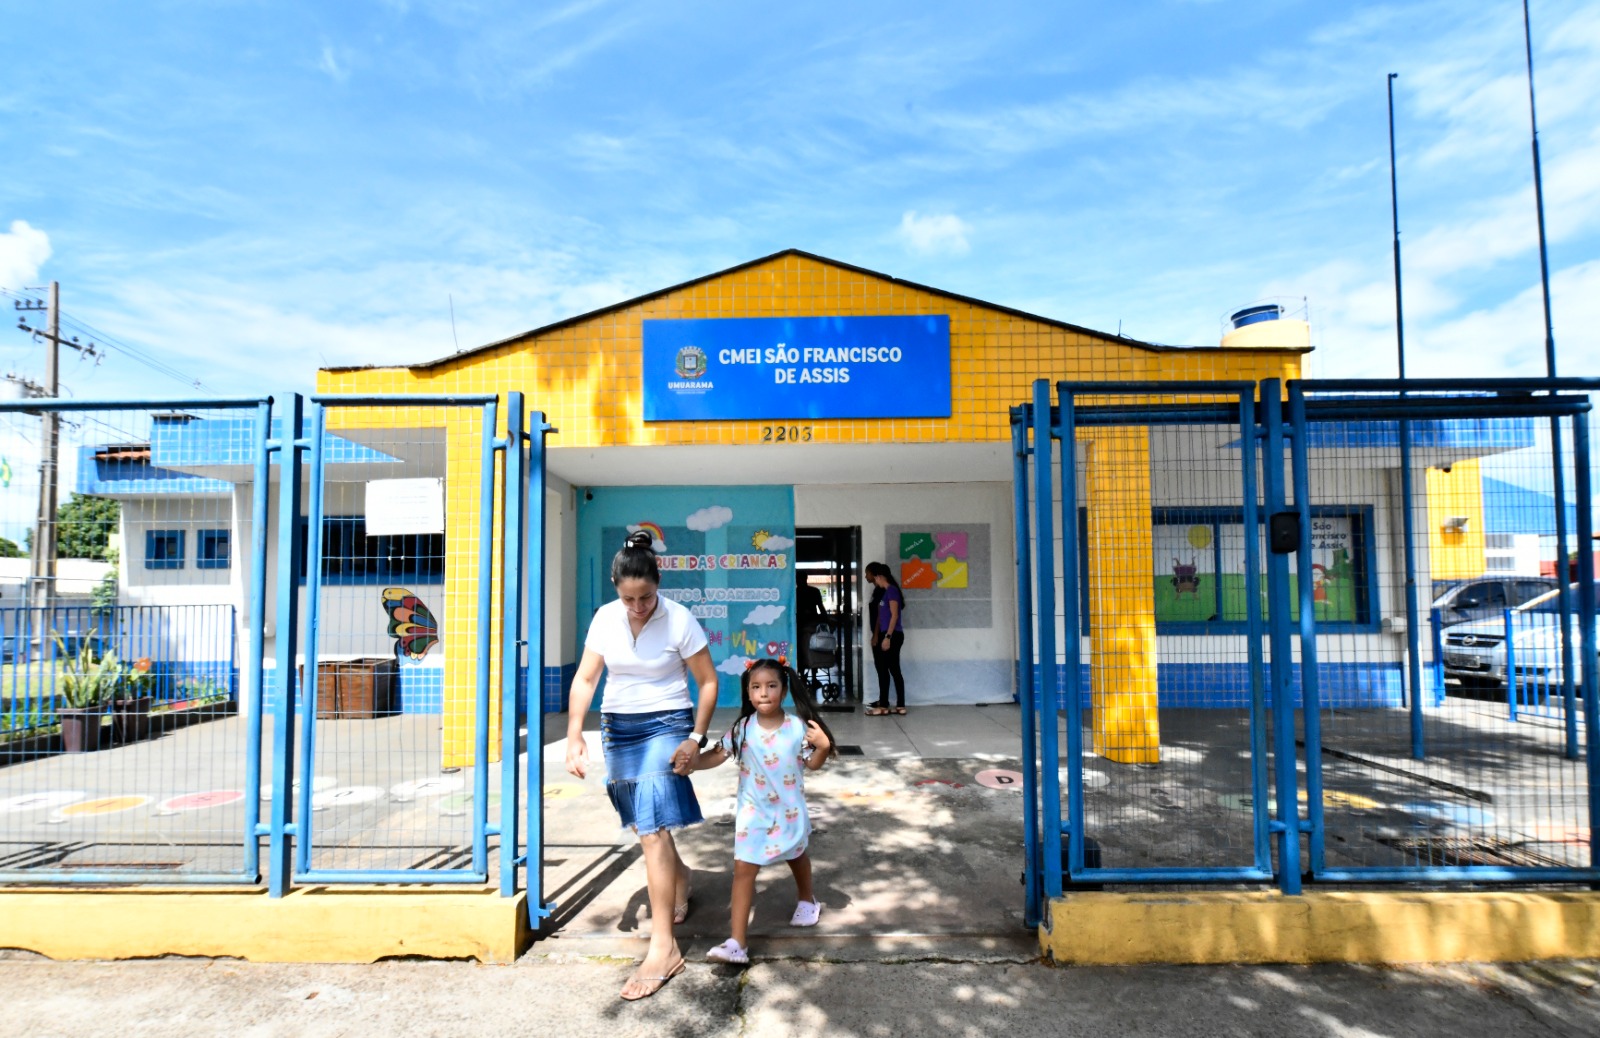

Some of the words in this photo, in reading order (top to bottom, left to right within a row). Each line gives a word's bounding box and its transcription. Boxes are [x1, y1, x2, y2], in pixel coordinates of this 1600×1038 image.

[719, 348, 761, 365] CMEI
[764, 343, 800, 364] SÃO
[803, 346, 902, 363] FRANCISCO
[775, 368, 796, 384] DE
[799, 367, 850, 384] ASSIS
[668, 381, 714, 390] UMUARAMA
